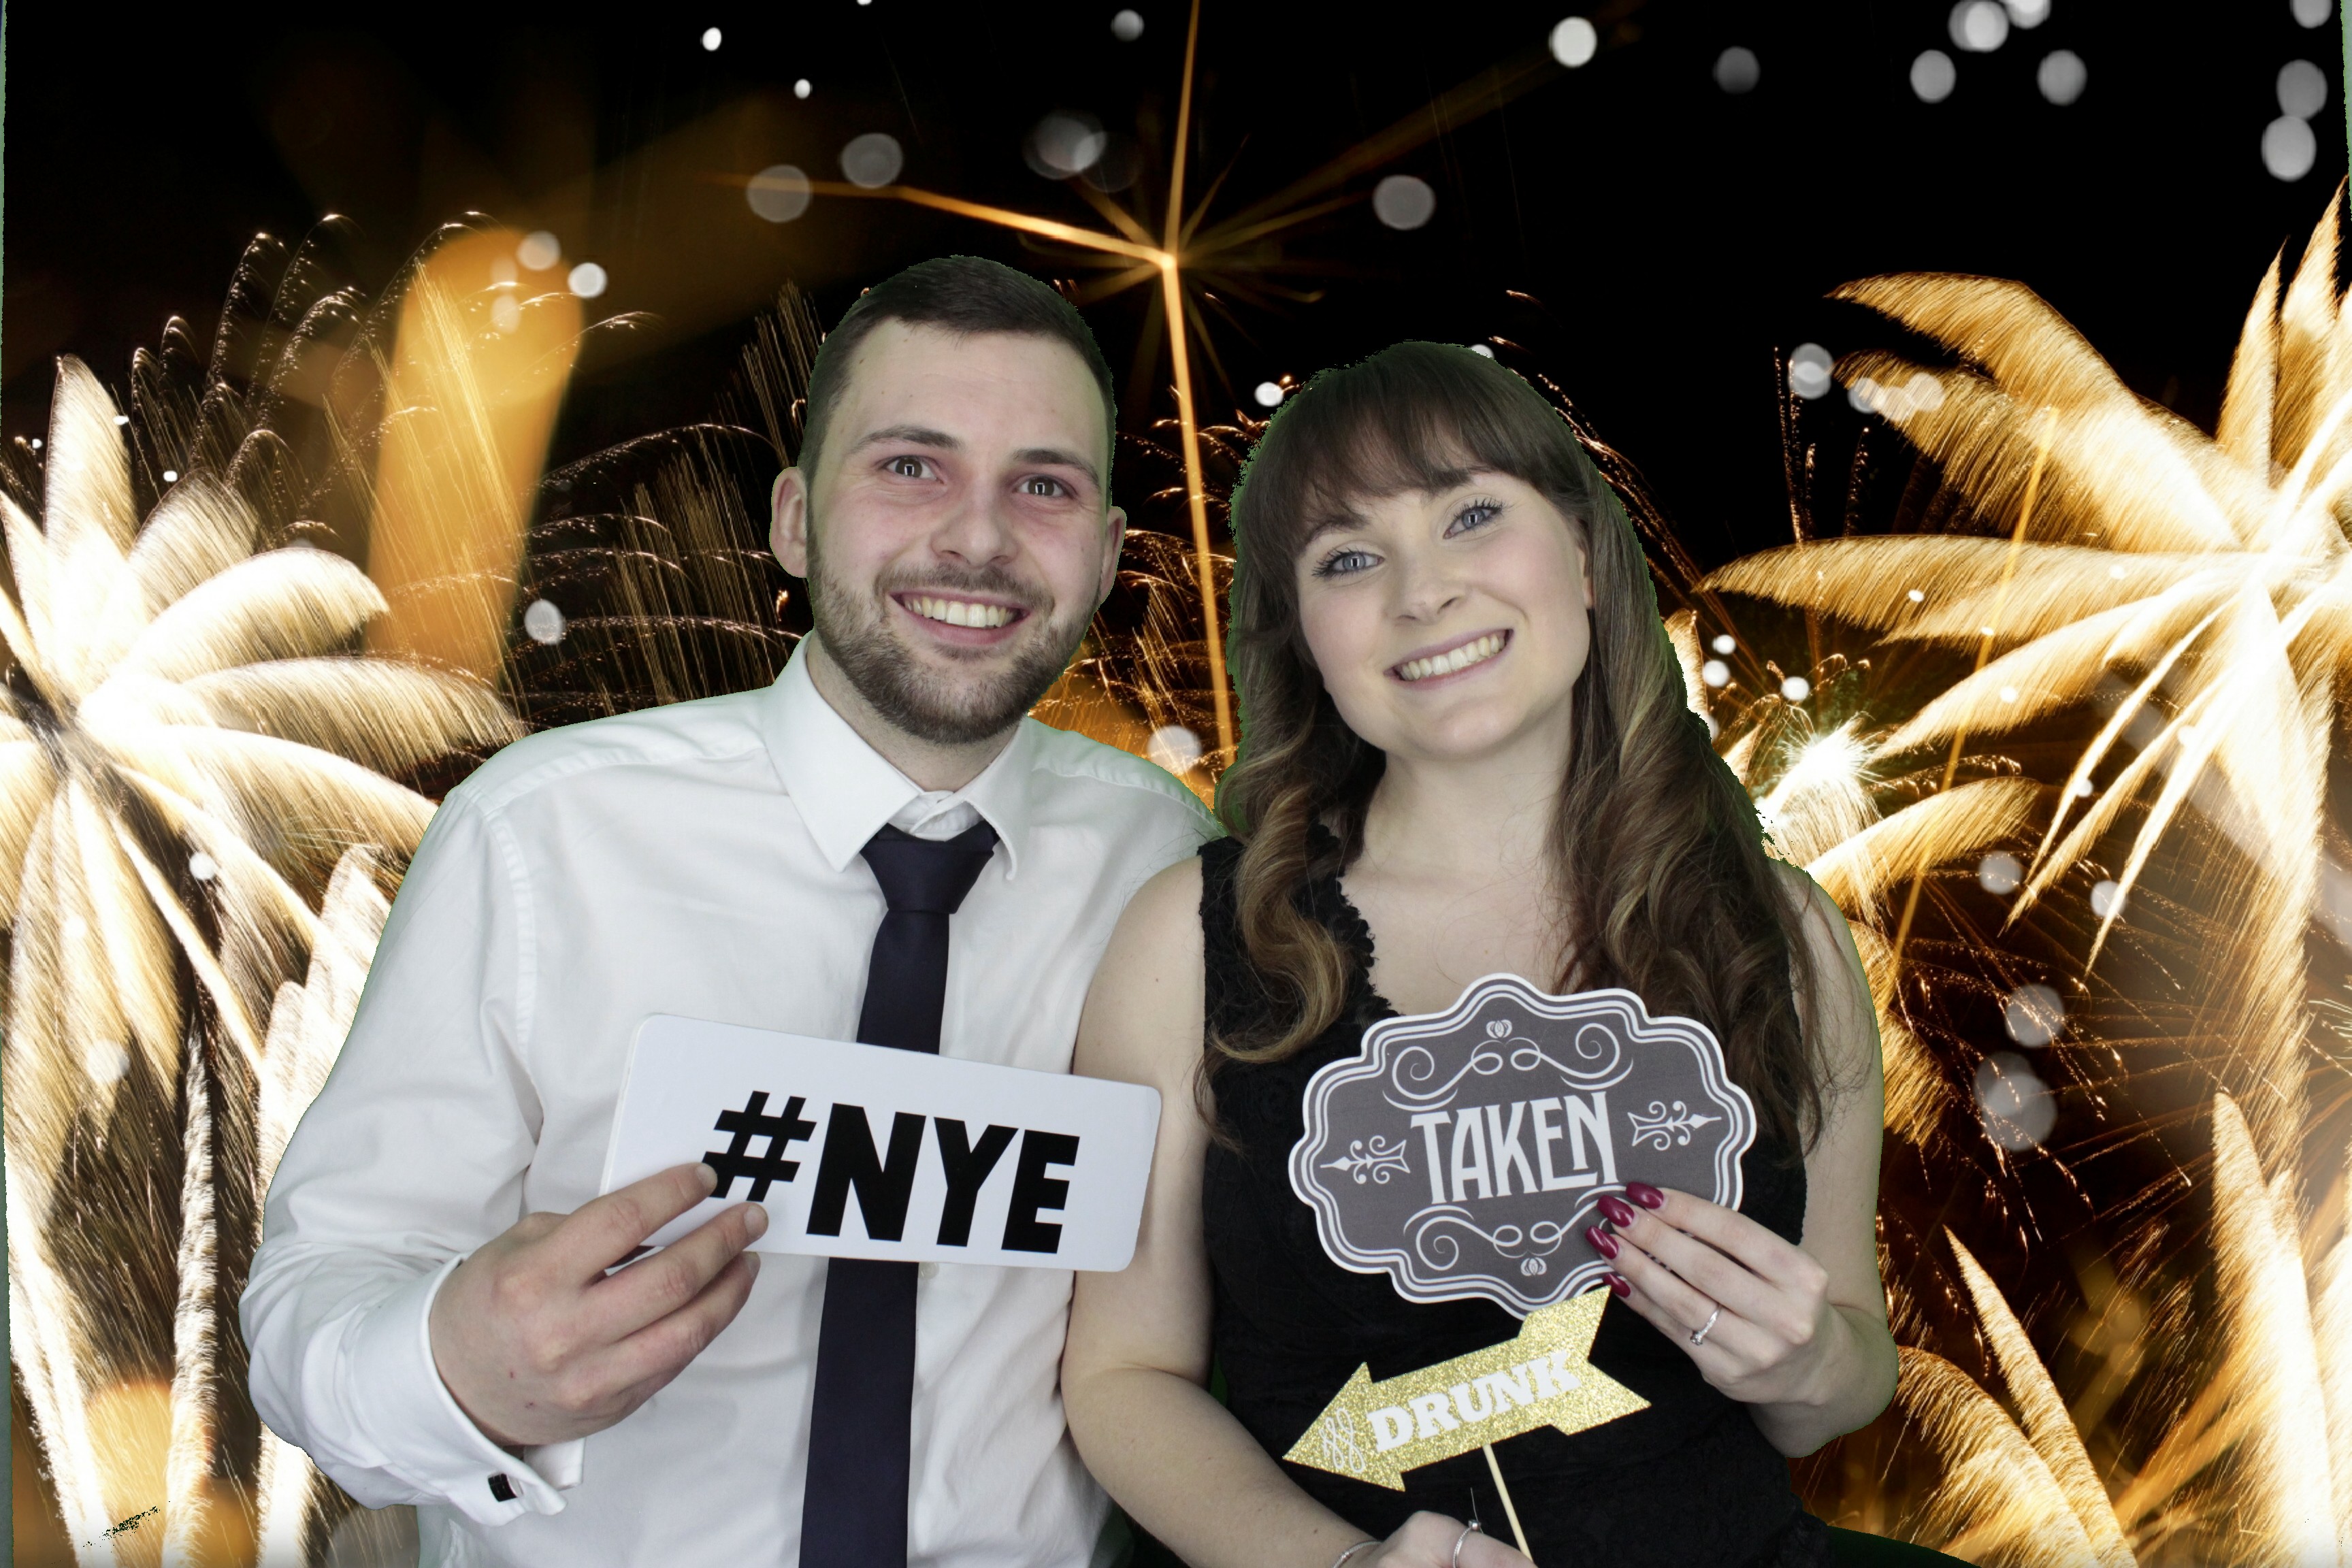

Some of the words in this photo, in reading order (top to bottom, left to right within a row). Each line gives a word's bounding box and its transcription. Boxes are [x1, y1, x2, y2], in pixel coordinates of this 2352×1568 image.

[701, 1090, 1080, 1254] #NYE
[1410, 1091, 1619, 1204] TAKEN
[1367, 1351, 1582, 1453] DRUNK
